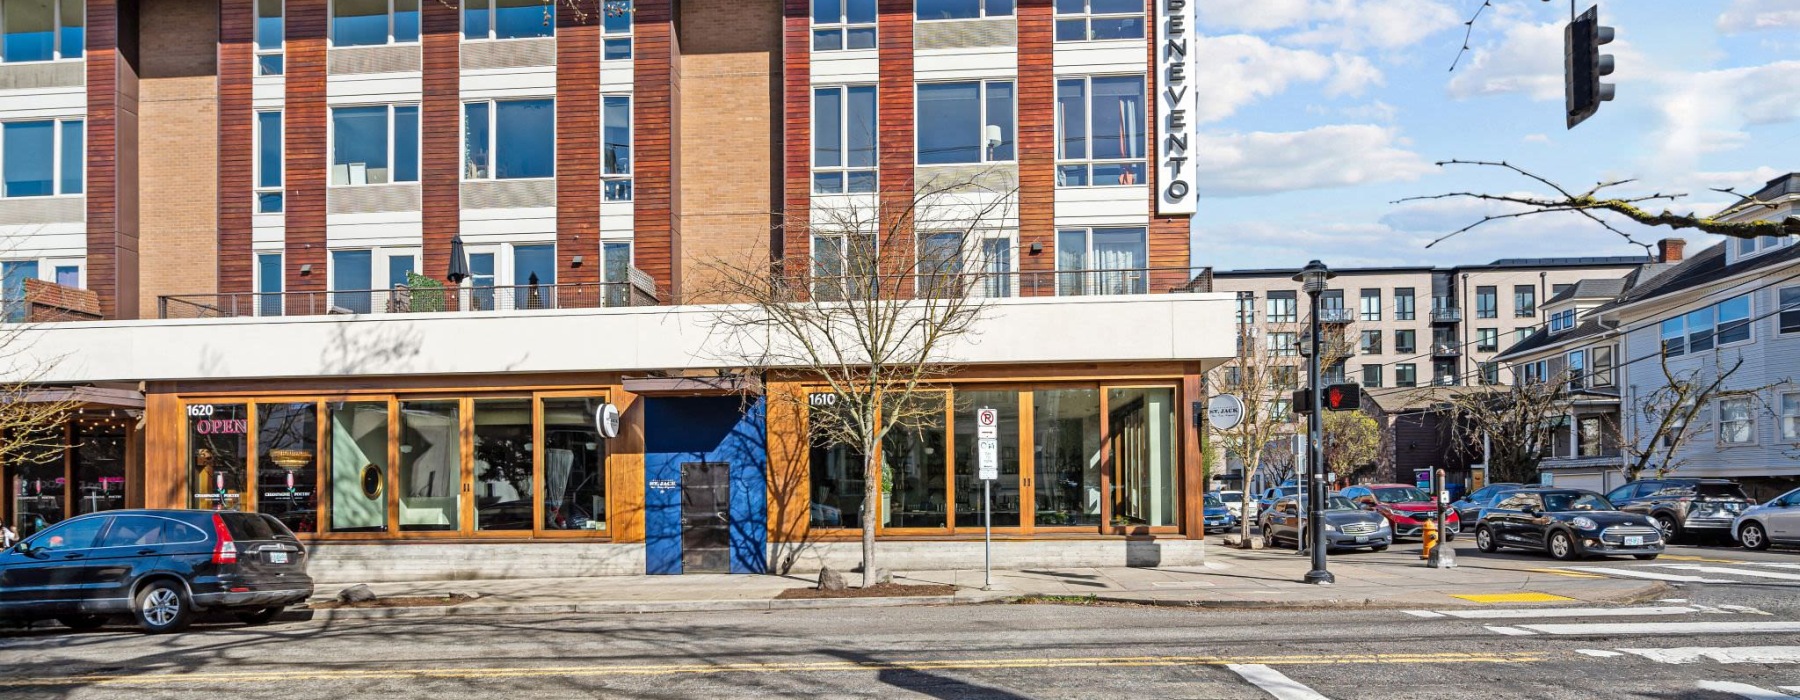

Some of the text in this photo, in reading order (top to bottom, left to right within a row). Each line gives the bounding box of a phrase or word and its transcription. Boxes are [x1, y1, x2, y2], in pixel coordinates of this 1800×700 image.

[809, 393, 836, 406] 1610
[187, 404, 214, 416] 1620
[197, 419, 247, 434] OPEN
